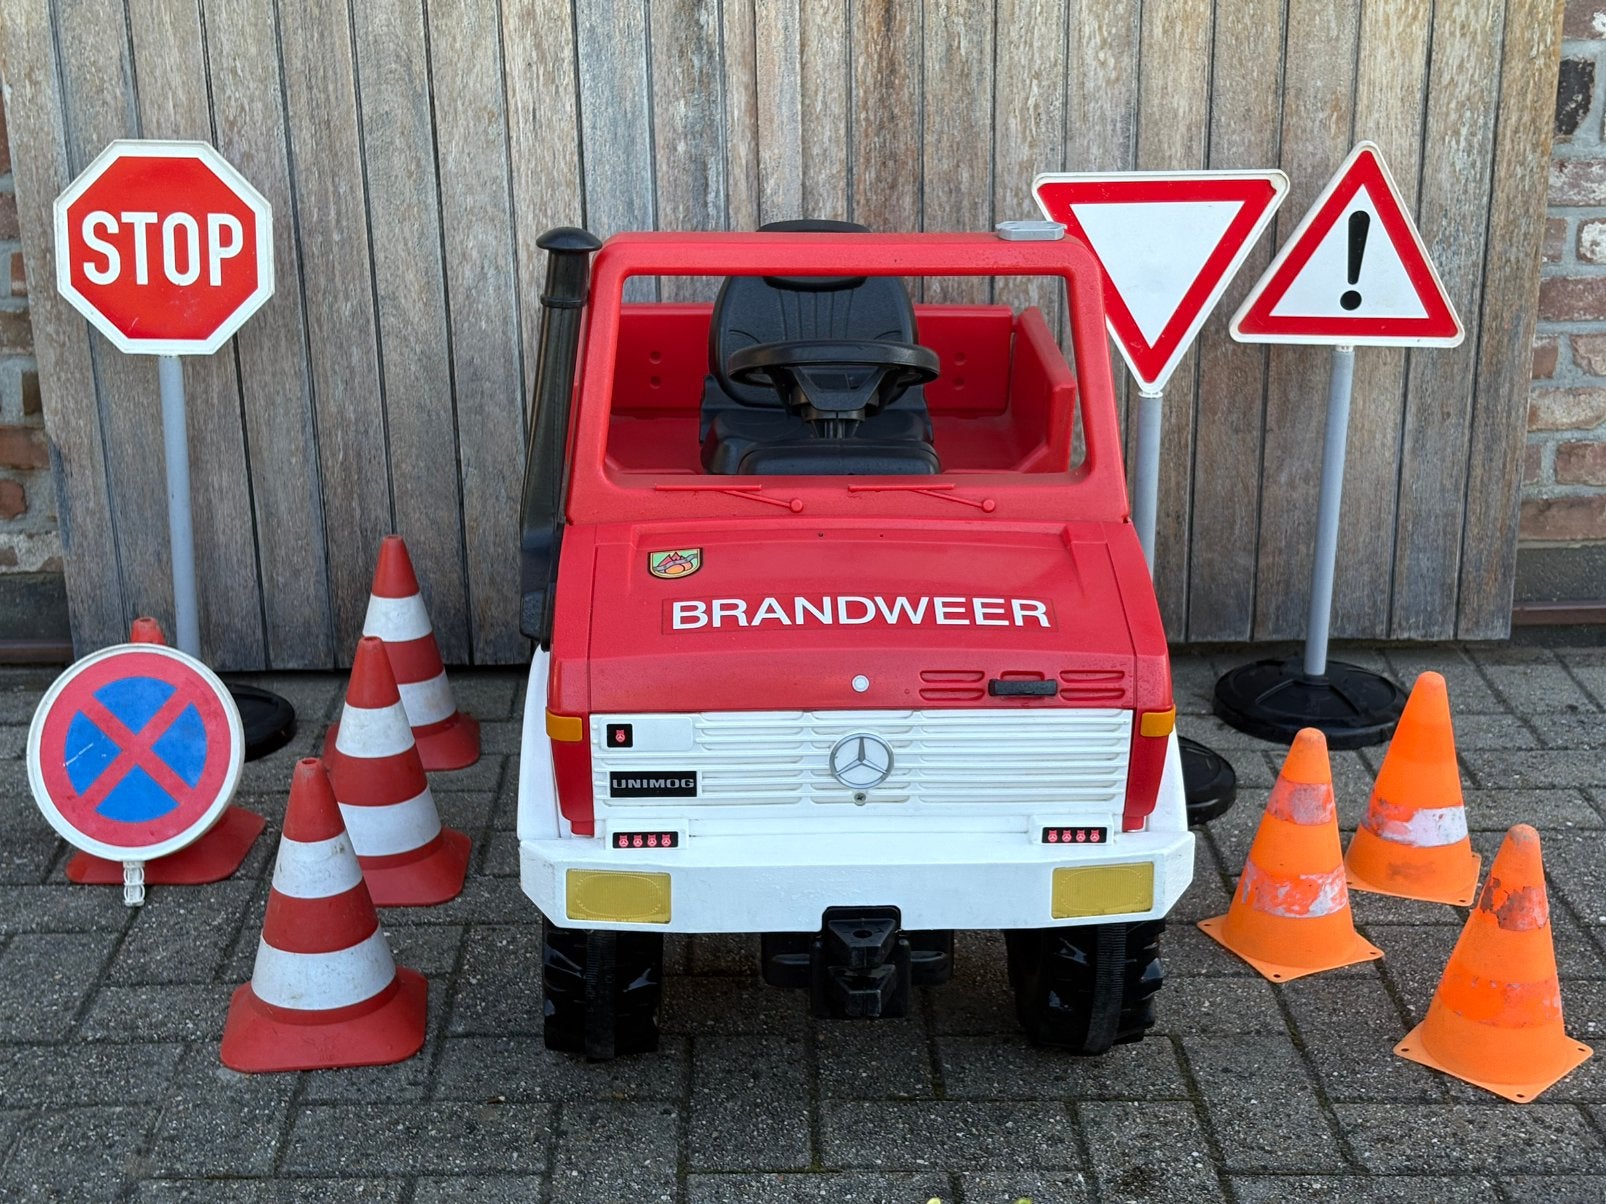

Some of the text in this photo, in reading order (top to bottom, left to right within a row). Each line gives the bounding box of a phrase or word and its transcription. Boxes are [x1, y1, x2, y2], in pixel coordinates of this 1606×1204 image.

[81, 210, 244, 287] STOP
[672, 596, 1051, 630] BRANDWEER
[612, 779, 695, 789] UNIMOG
